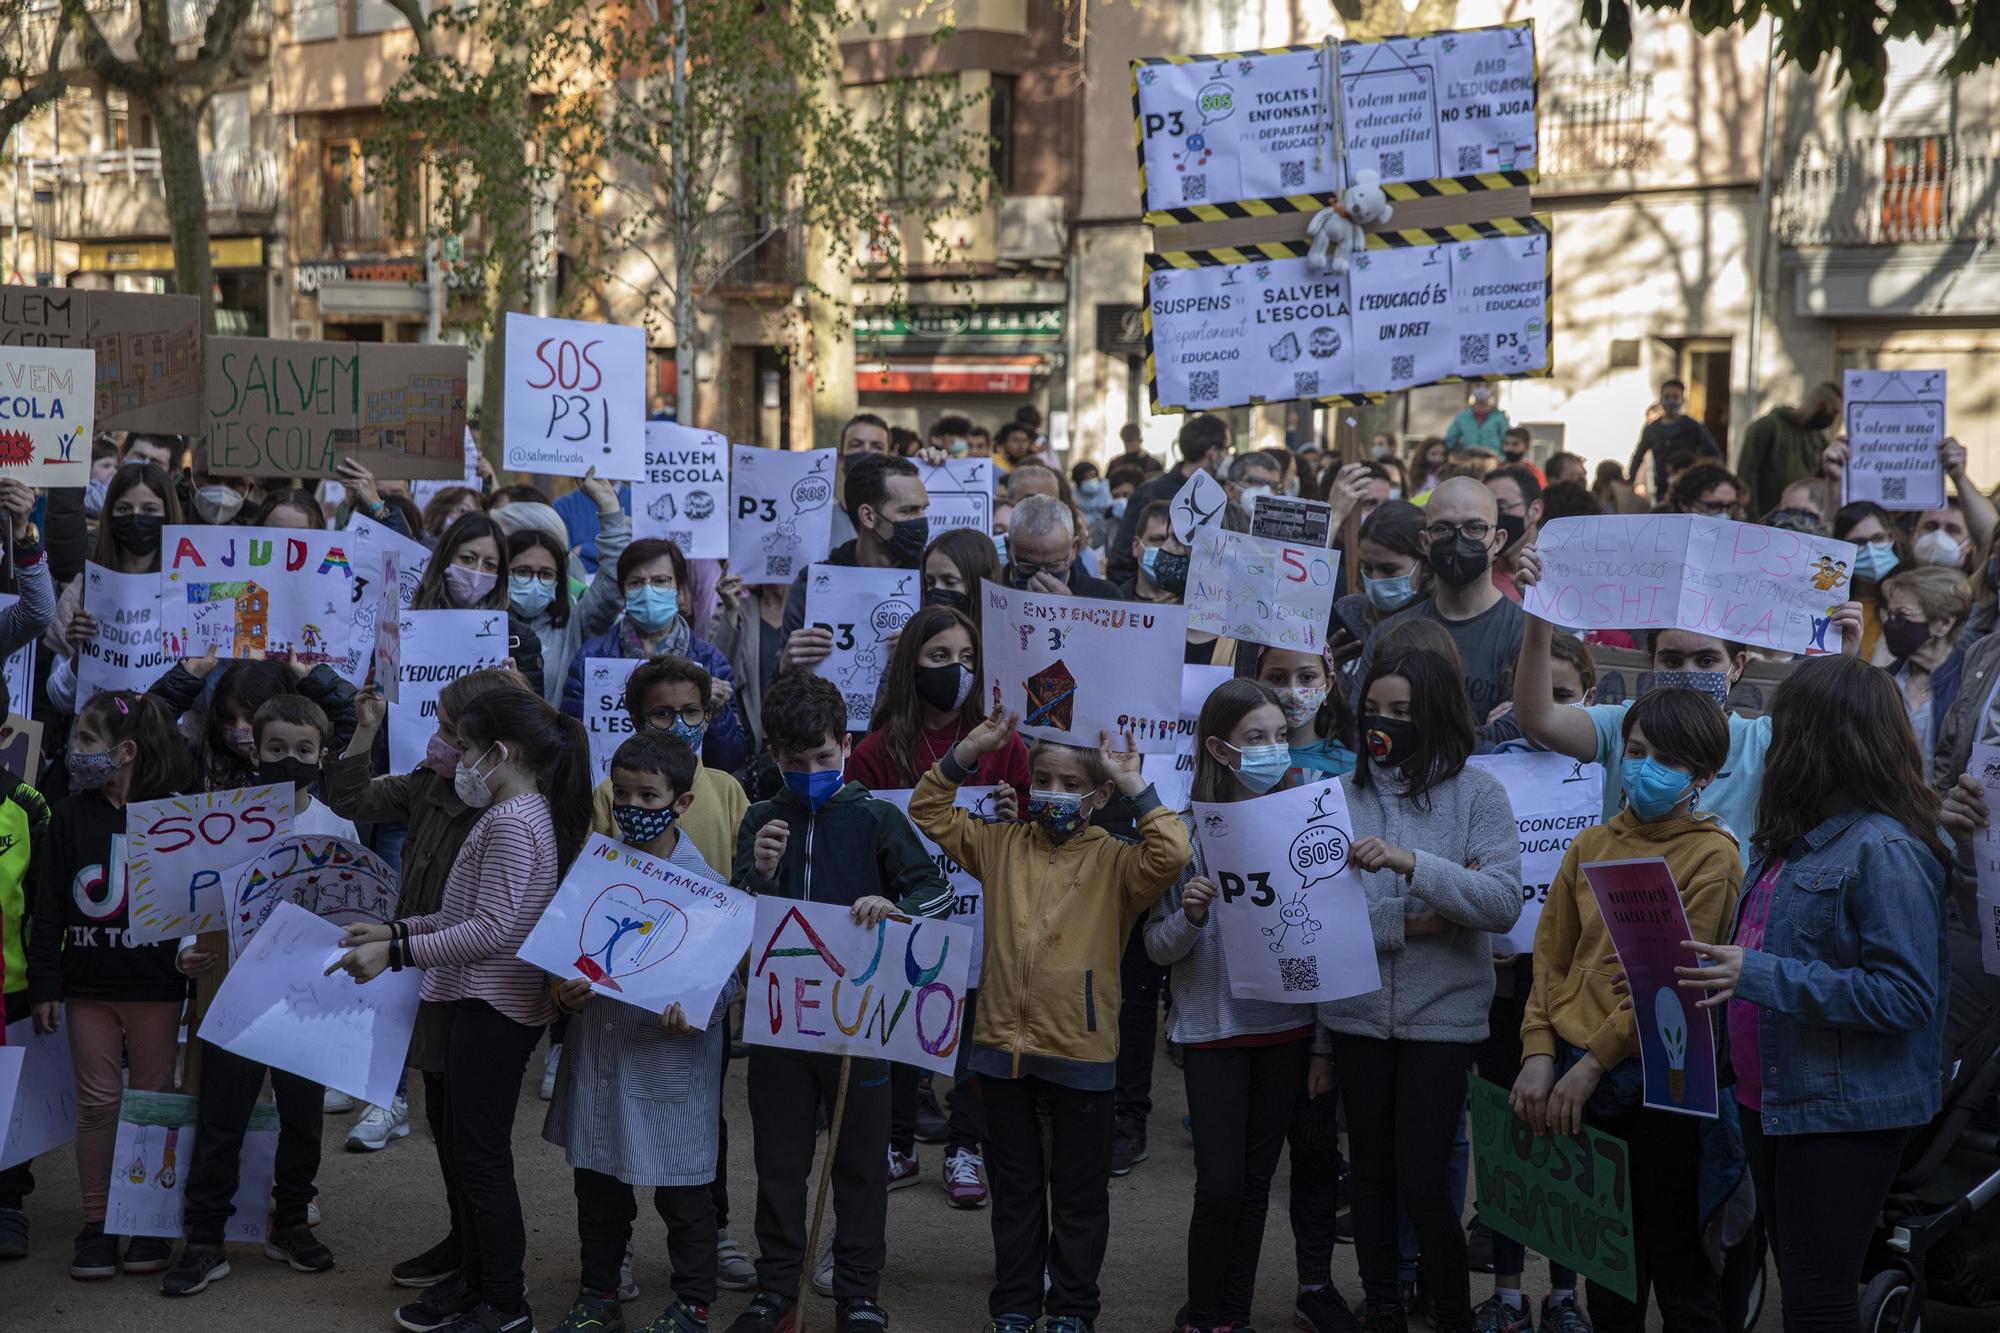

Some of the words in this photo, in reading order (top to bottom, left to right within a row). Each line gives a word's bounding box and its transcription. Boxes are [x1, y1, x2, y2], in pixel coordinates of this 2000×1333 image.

[1474, 58, 1507, 76] AMB
[1202, 93, 1232, 111] SOS
[1256, 91, 1309, 105] TOCATS
[1312, 88, 1318, 101] I
[1398, 89, 1427, 104] una
[1249, 103, 1327, 123] ENFONSATS
[1355, 105, 1423, 130] educació
[1441, 106, 1460, 123] NO
[1464, 103, 1491, 120] S'HI
[1496, 100, 1532, 117] JUGA
[1146, 110, 1185, 139] P3
[1350, 137, 1367, 150] de
[1371, 126, 1431, 150] qualitat
[1264, 284, 1341, 304] SALVEM
[1359, 286, 1429, 312] L'EDUCACIÓ
[1433, 283, 1448, 304] ÉS
[1472, 280, 1544, 298] DESCONCERT
[2, 294, 71, 328] LEM
[1153, 294, 1232, 316] SUSPENS
[1256, 302, 1351, 324] L'ESCOLA
[1379, 323, 1396, 341] UN
[1399, 321, 1431, 338] DRET
[1496, 332, 1519, 349] P3
[527, 338, 603, 392] SOS
[1181, 345, 1240, 364] EDUCACIÓ
[6, 362, 73, 395] VEM
[212, 353, 359, 417] SALVEM
[0, 397, 65, 419] COLA
[546, 394, 611, 454] P3!
[1904, 422, 1935, 434] una
[210, 423, 336, 473] L'ESCOLA
[509, 446, 585, 466] @salvemlescola
[1859, 438, 1929, 453] educació
[645, 467, 724, 483] 'ESCOLA
[1853, 457, 1872, 471] de
[1874, 457, 1937, 473] qualitat
[738, 496, 777, 522] P3
[795, 486, 827, 502] SOS
[1537, 515, 1721, 563] SALVEM
[172, 537, 353, 579] AJUDA
[1282, 548, 1332, 587] 50
[1543, 561, 1570, 577] MB
[351, 576, 370, 603] 3
[1528, 586, 1583, 622] NO
[115, 608, 151, 624] AMB
[82, 641, 99, 658] NO
[103, 649, 128, 668] S'HI
[147, 806, 275, 853] SOS
[593, 843, 618, 862] NO
[624, 854, 662, 880] VOLEM
[1218, 871, 1277, 907] P3
[1297, 838, 1344, 868] SOS
[189, 870, 221, 912] P
[951, 895, 979, 916] RET
[104, 927, 159, 950] TO
[1478, 1155, 1629, 1272] SALVEM
